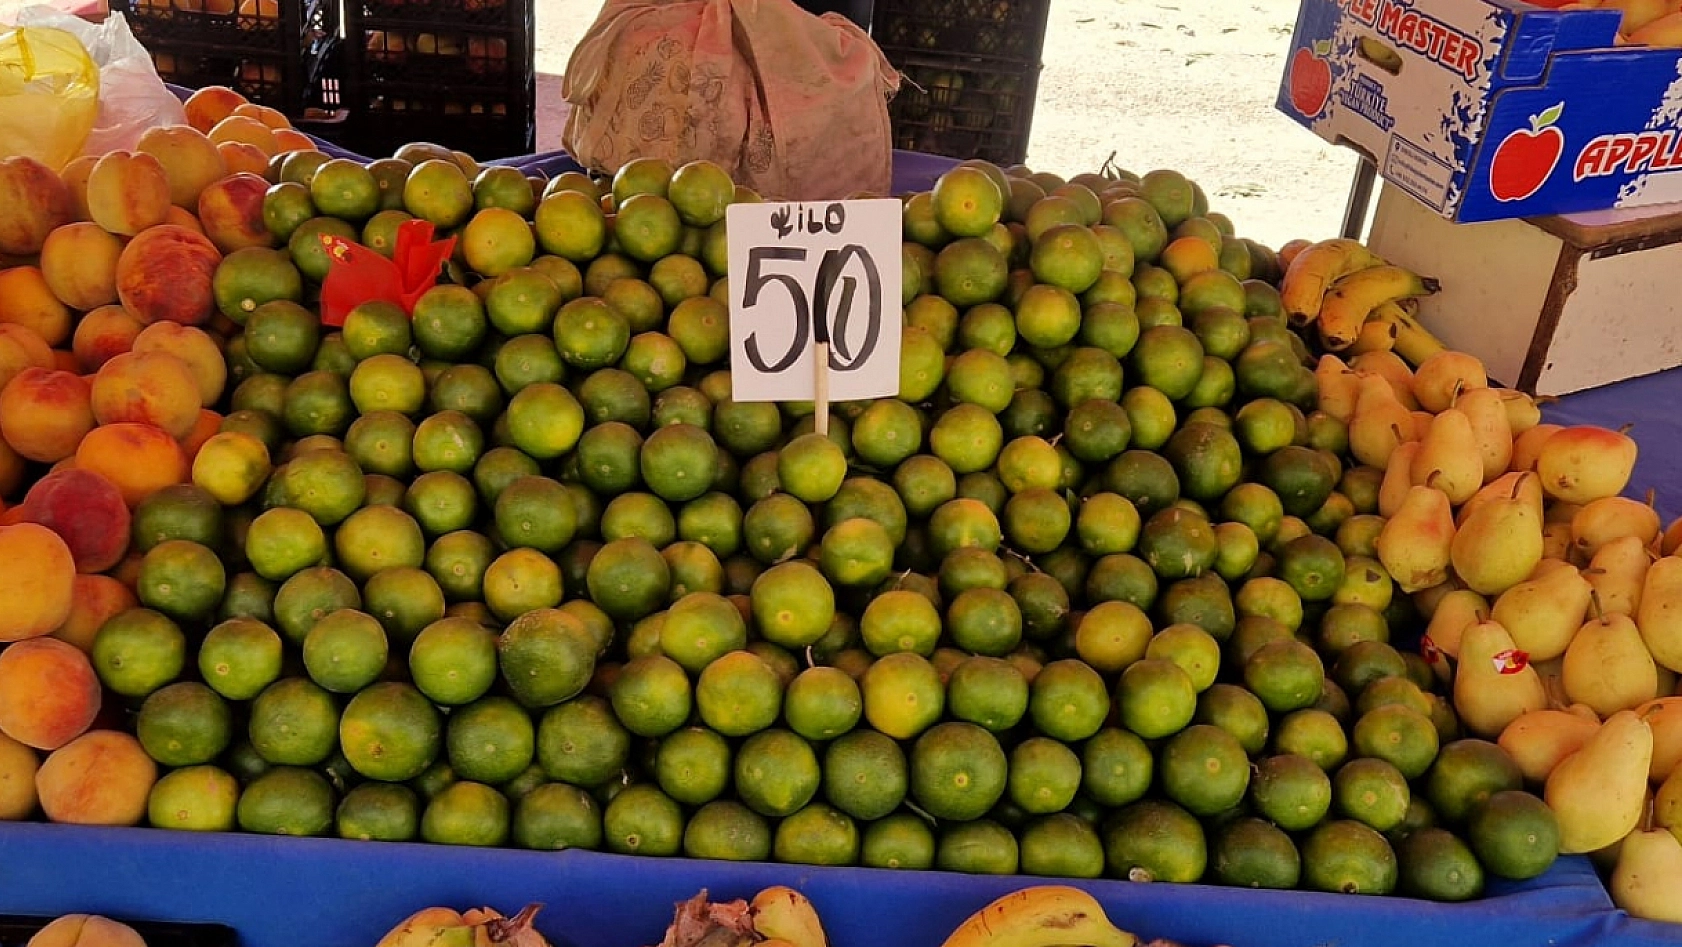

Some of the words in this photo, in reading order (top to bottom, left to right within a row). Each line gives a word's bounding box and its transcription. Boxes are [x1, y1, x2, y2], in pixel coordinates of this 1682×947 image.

[1337, 0, 1375, 21] LE
[1379, 2, 1479, 77] MASTER
[743, 244, 882, 373] 50
